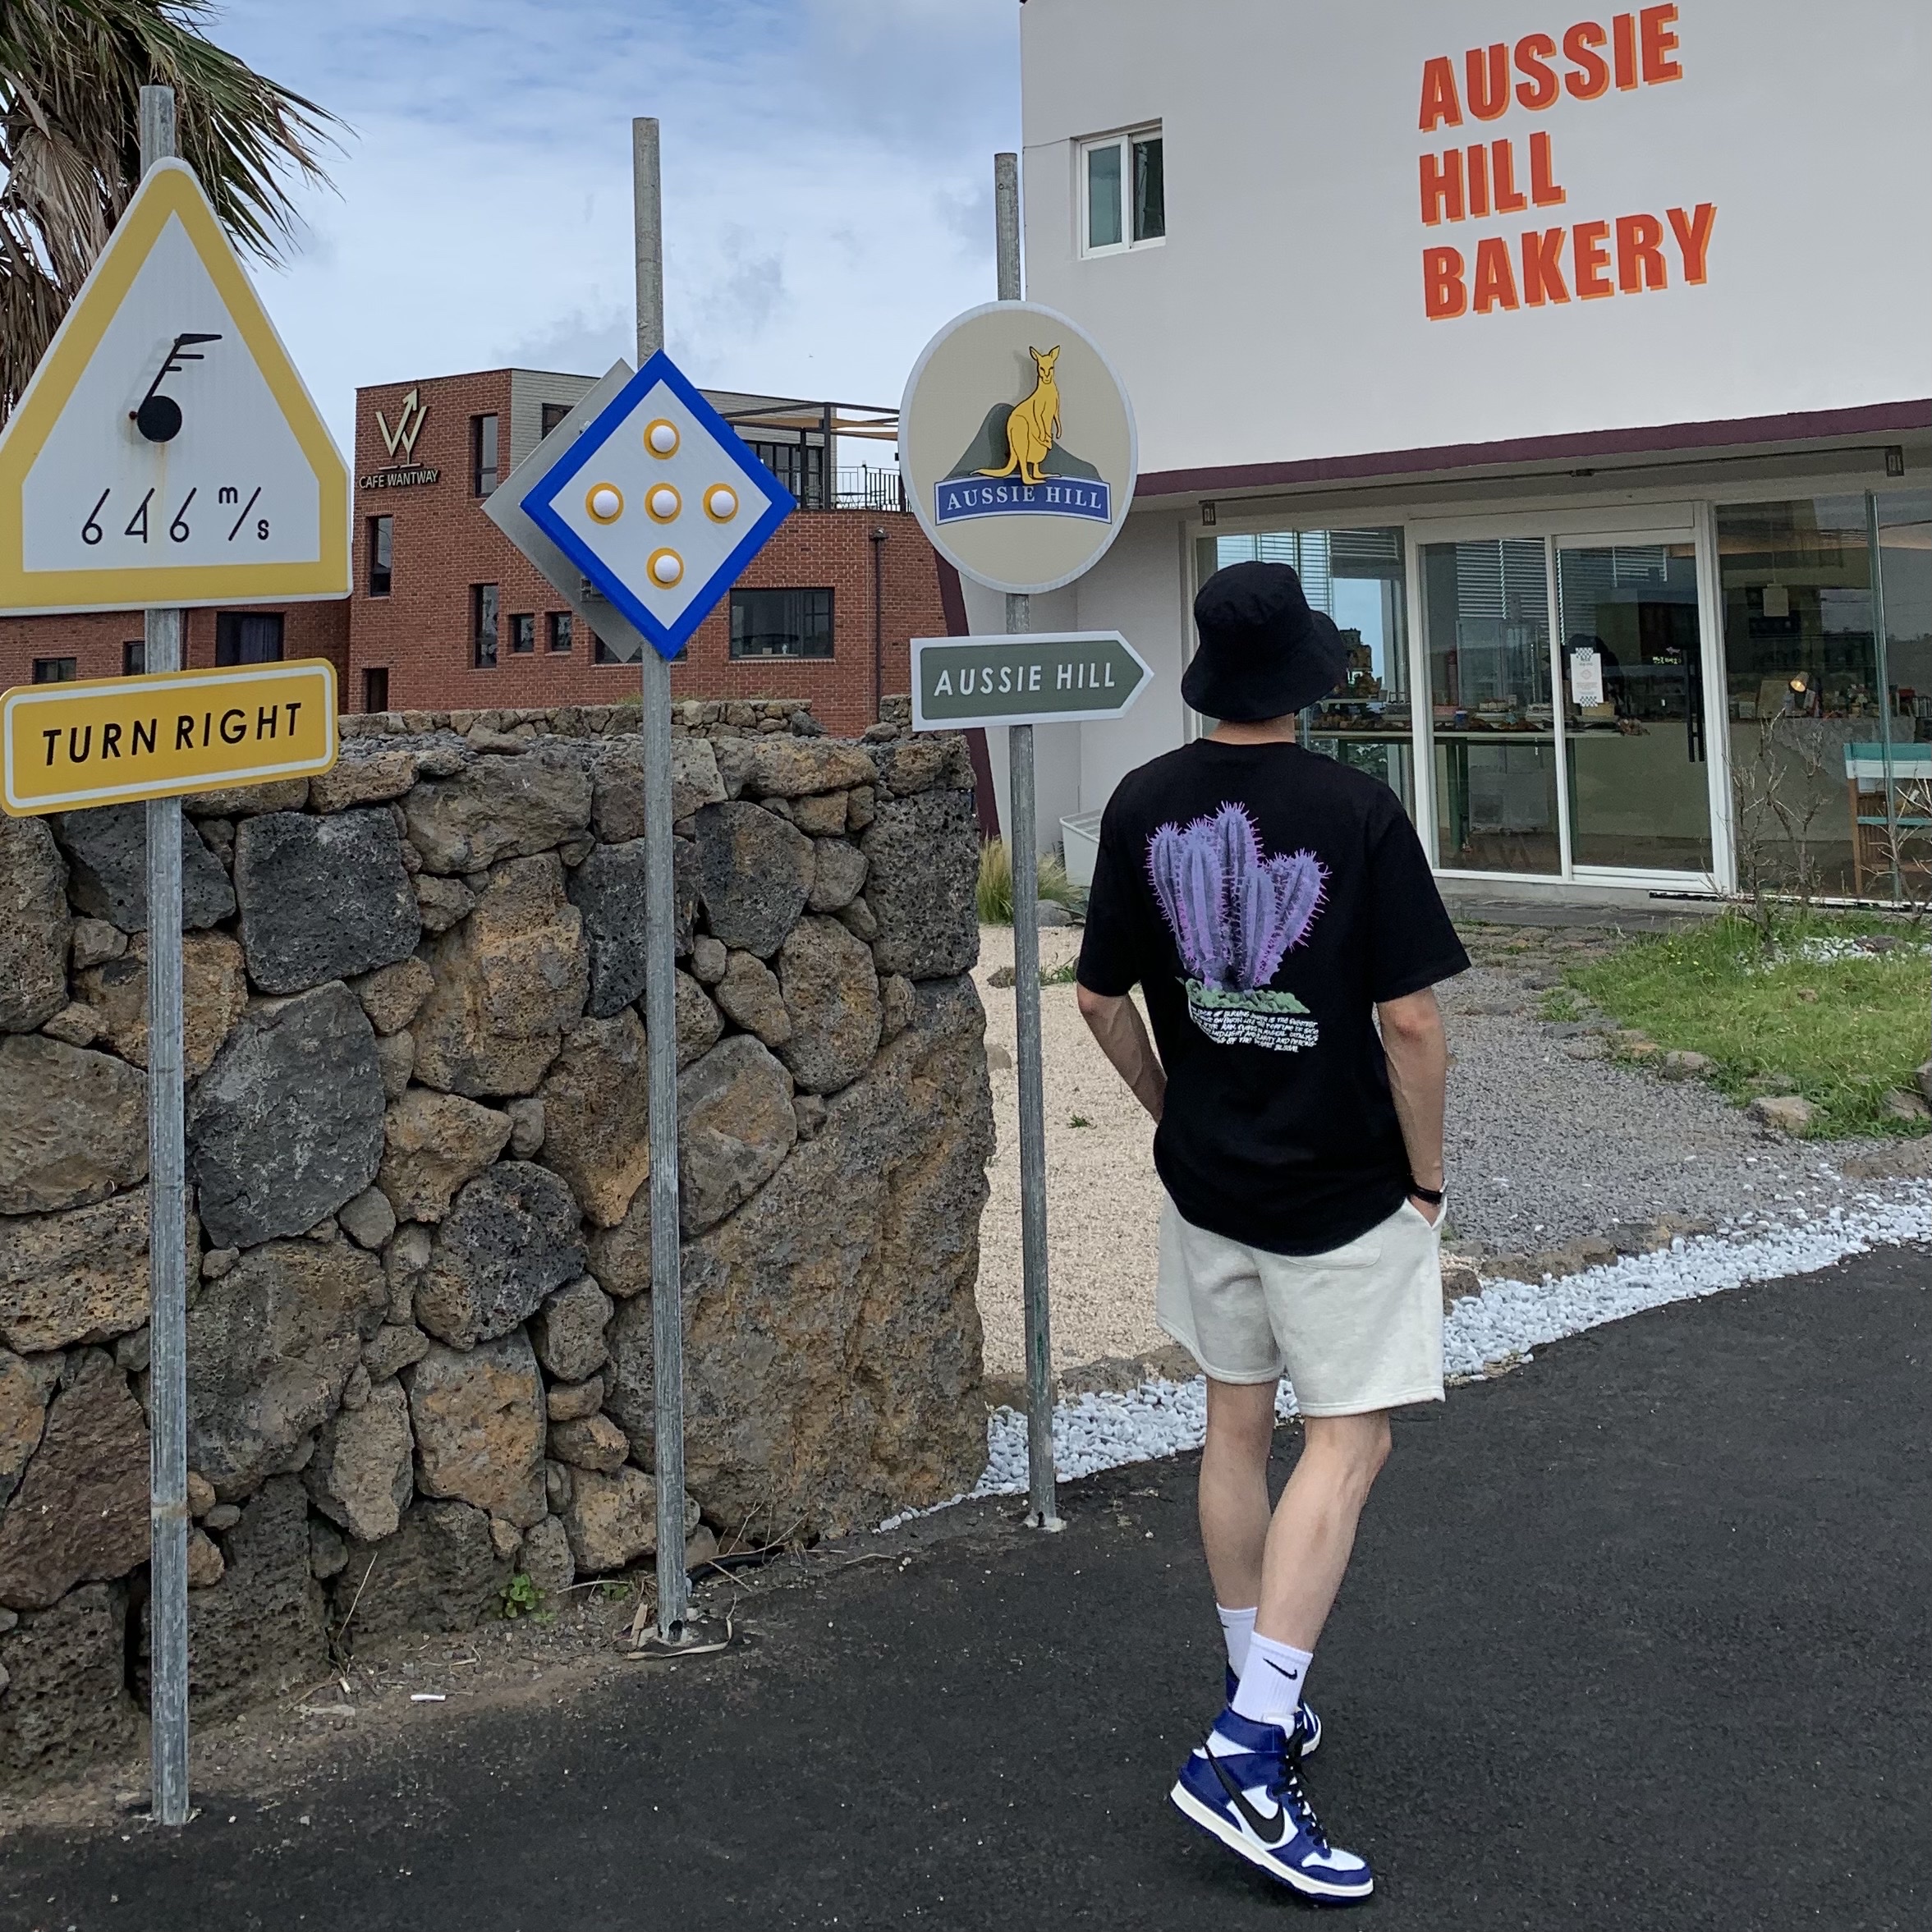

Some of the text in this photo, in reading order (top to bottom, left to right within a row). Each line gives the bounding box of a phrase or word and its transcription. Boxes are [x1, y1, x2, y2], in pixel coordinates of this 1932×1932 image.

[1419, 2, 1682, 133] AUSSIE
[1420, 131, 1566, 227] HILL
[1423, 202, 1717, 321] BAKERY
[359, 470, 438, 489] CAFE WANTWAY
[947, 485, 1103, 511] AUSSIE HILL
[934, 662, 1116, 697] AUSSIE HILL
[43, 702, 302, 767] TURN RIGHT
